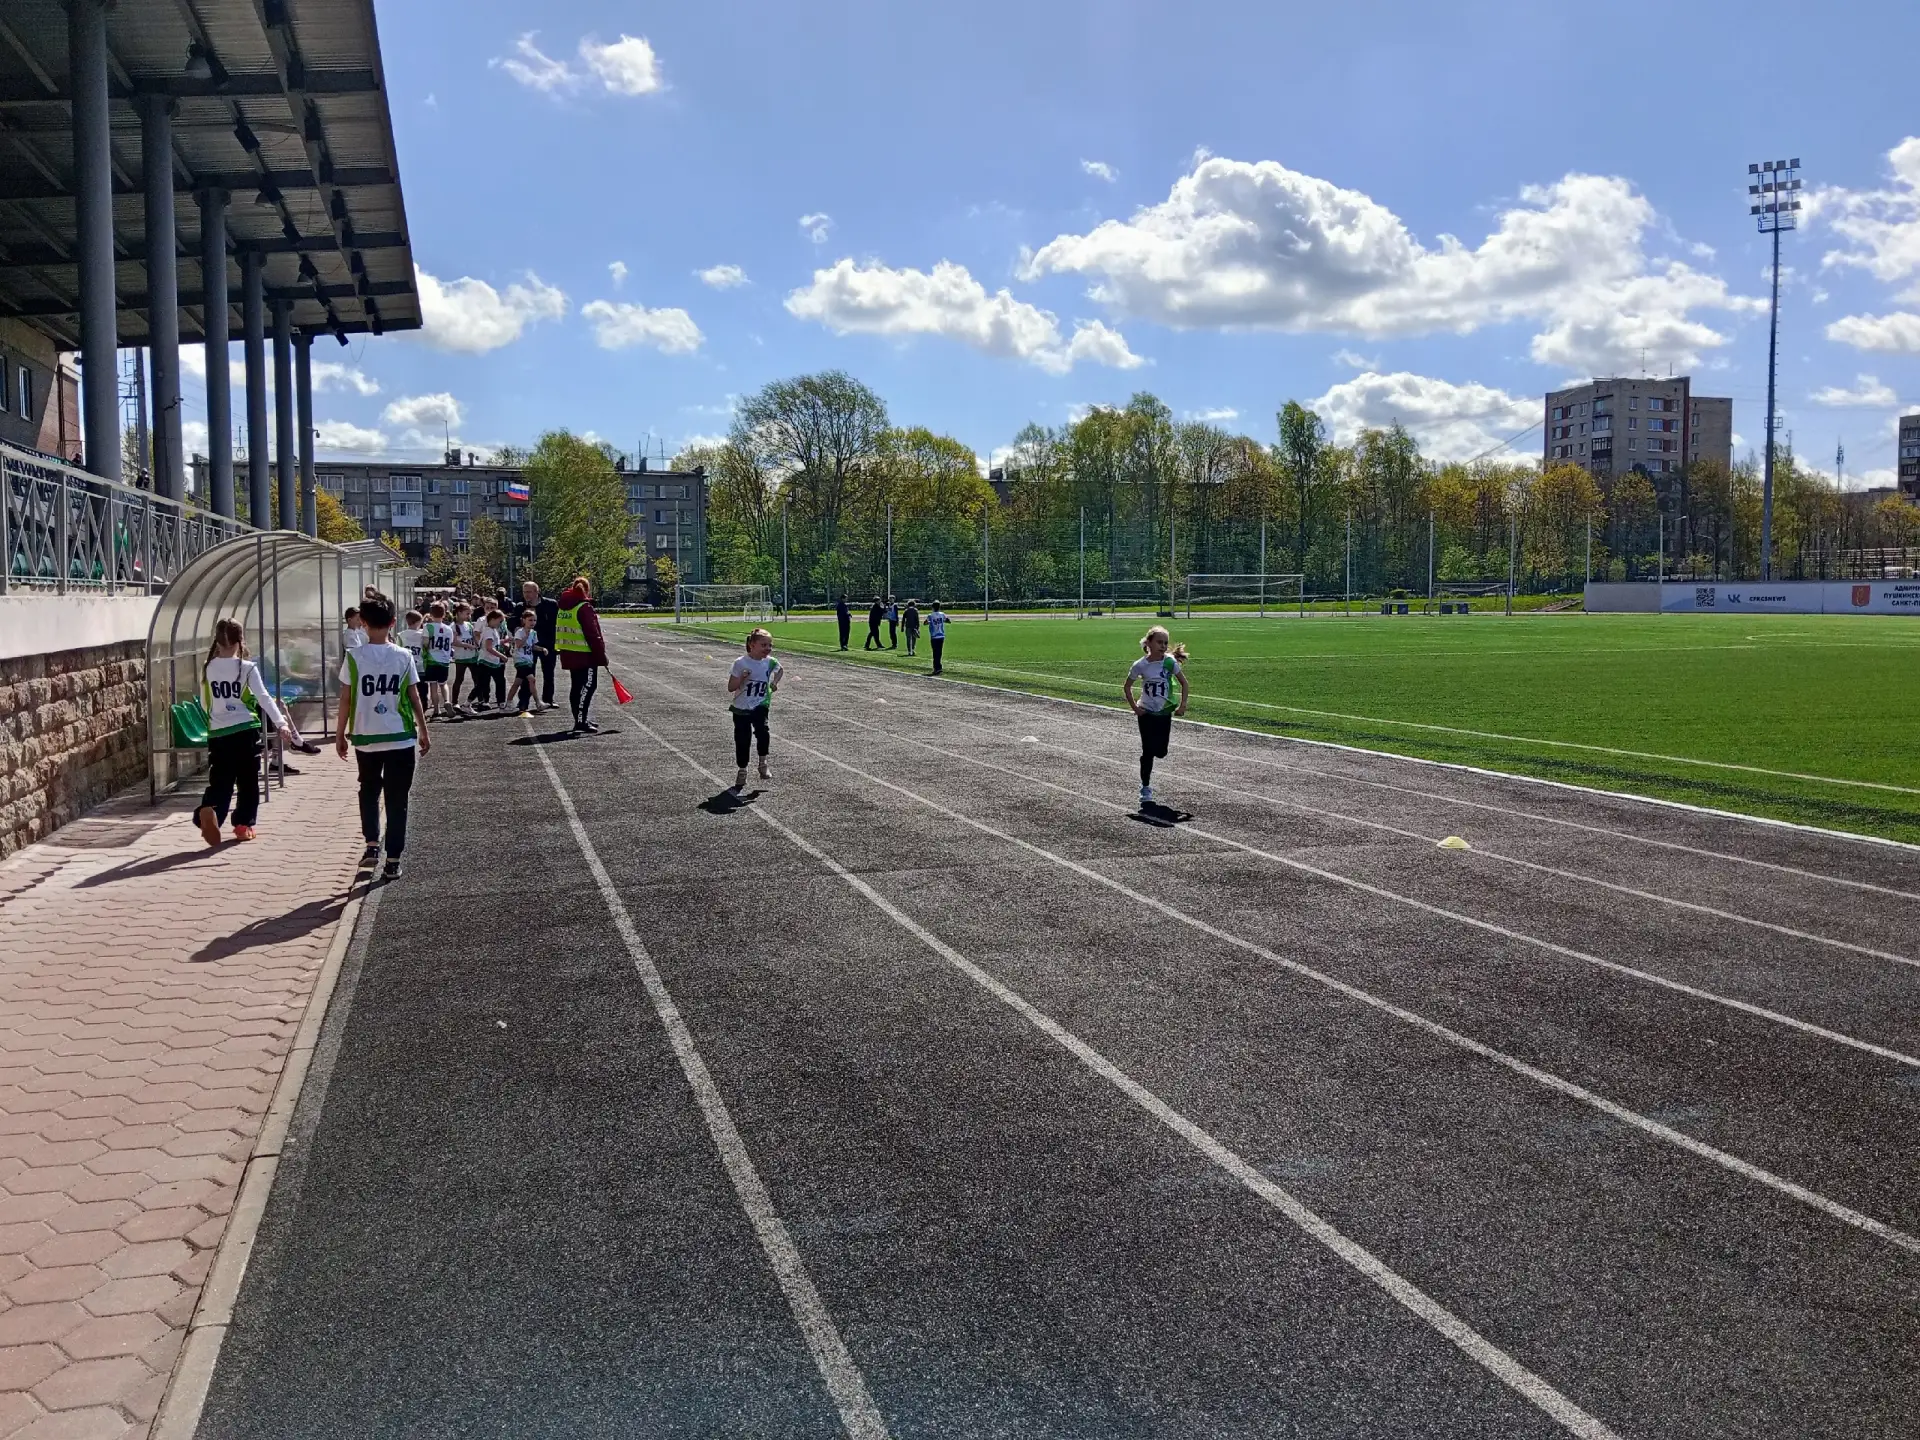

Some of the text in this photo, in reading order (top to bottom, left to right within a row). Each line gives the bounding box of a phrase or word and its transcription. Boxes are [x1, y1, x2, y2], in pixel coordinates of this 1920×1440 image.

[429, 635, 450, 652] 148
[210, 680, 242, 699] 609
[361, 673, 401, 697] 644
[746, 681, 768, 697] 119
